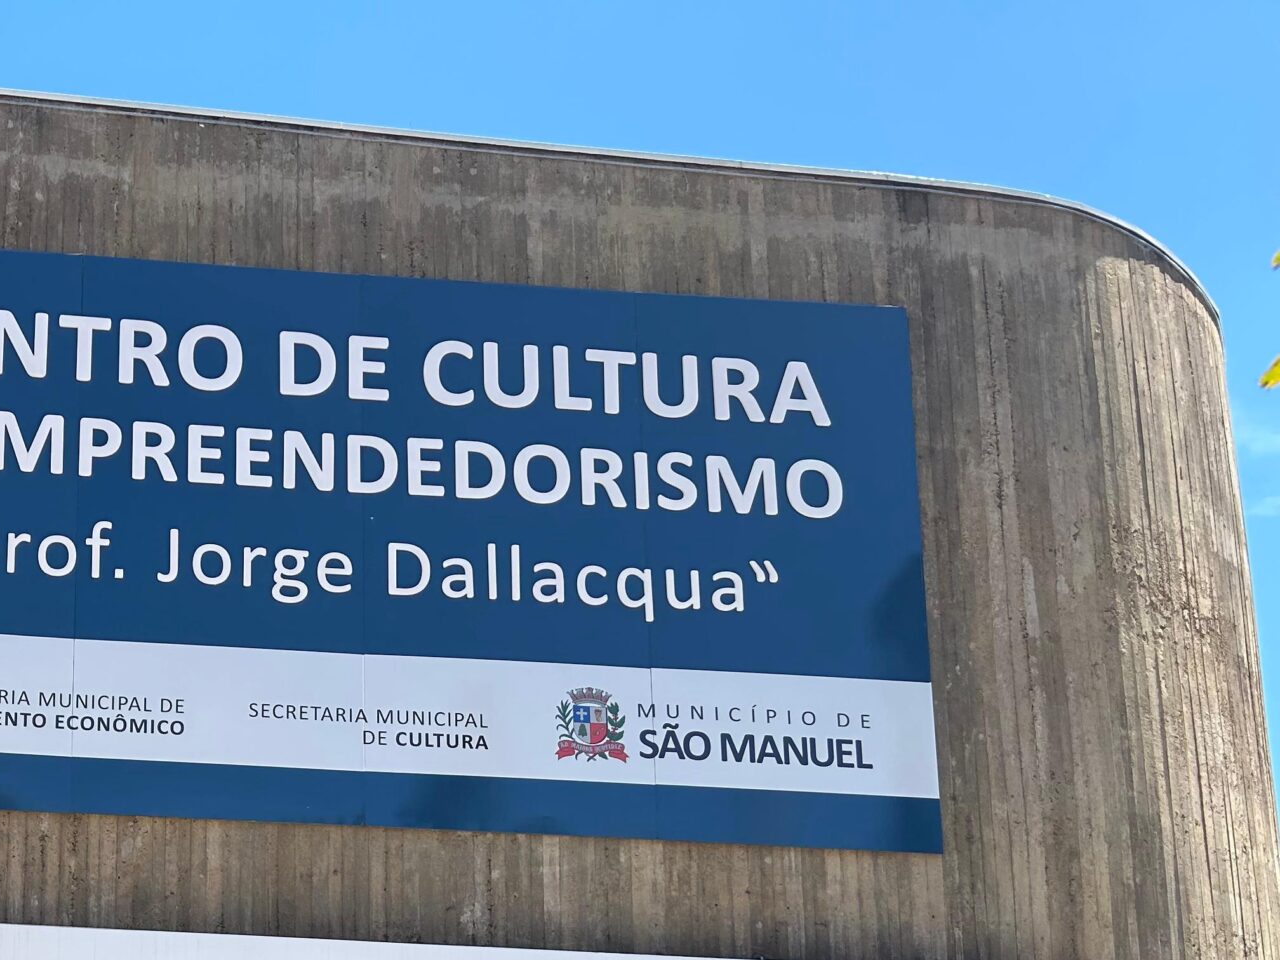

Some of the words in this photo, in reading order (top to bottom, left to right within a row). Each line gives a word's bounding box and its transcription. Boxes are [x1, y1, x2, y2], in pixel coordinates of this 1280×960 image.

[278, 330, 390, 403] DE
[422, 339, 832, 427] CULTURA
[157, 528, 355, 604] Jorge
[39, 691, 152, 712] MUNICIPAL
[160, 698, 185, 714] DE
[55, 714, 185, 736] ECONÔMICO
[249, 703, 368, 723] SECRETARIA
[376, 709, 488, 728] MUNICIPAL
[637, 703, 816, 726] MUNICÍPIO
[837, 713, 871, 728] DE
[363, 730, 388, 745] DE
[395, 732, 488, 749] CULTURA
[639, 723, 711, 760] SÃO
[720, 733, 874, 769] MANUEL
